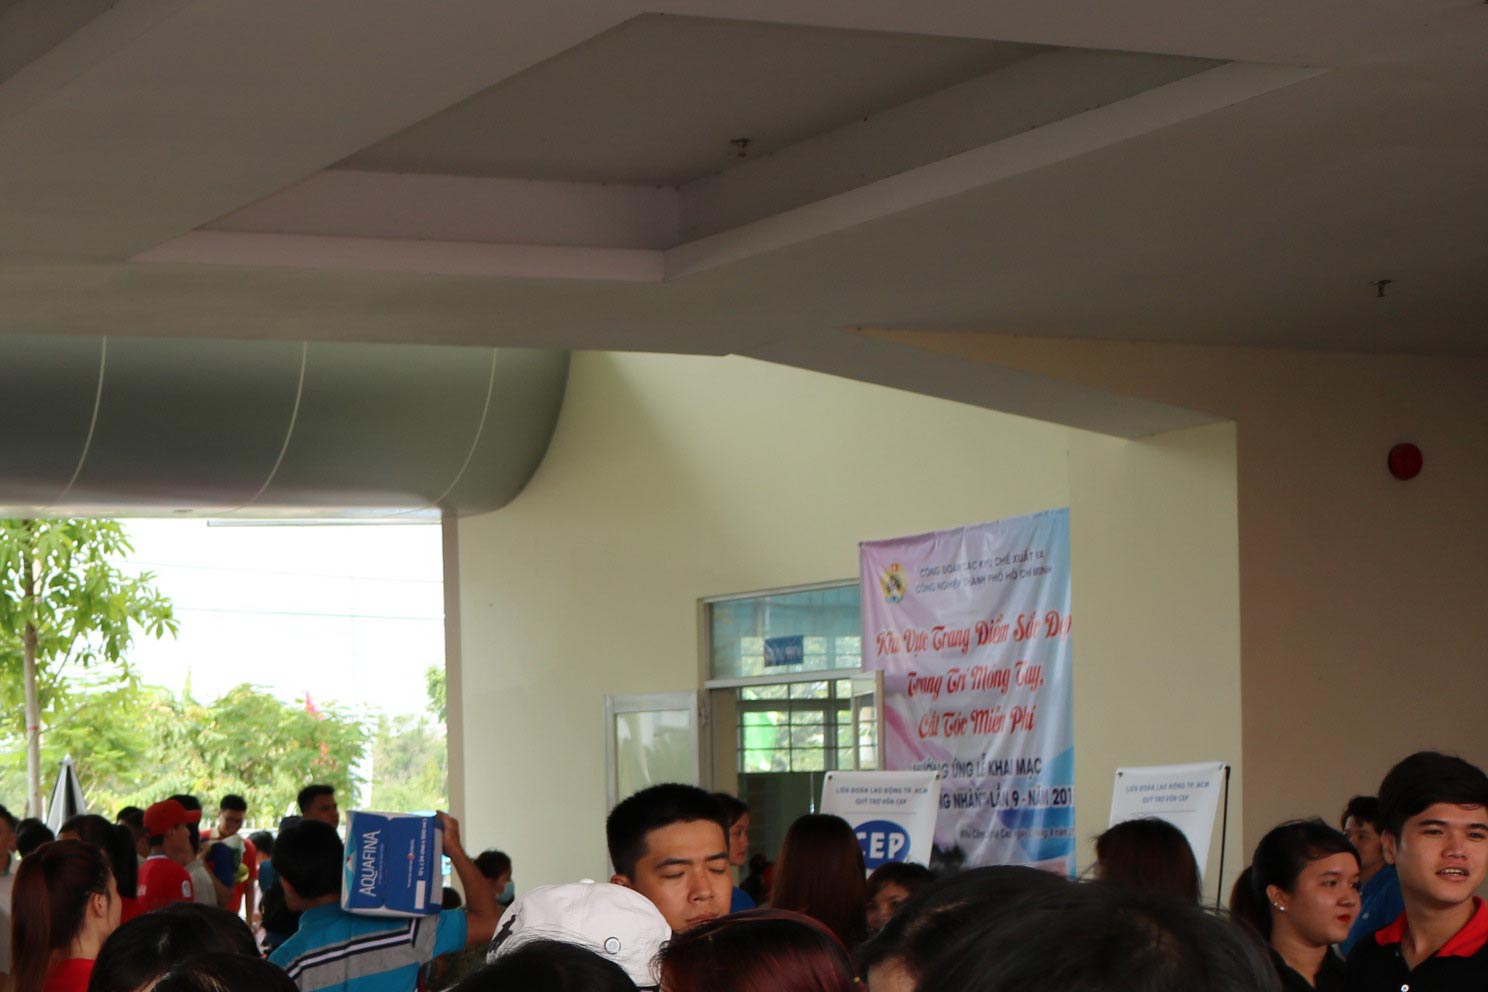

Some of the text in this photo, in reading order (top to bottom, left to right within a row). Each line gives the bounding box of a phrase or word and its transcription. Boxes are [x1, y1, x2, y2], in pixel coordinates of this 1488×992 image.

[931, 625, 971, 655] Trang
[906, 670, 944, 700] Trang
[1012, 789, 1019, 807] 9
[359, 828, 382, 897] AQUAFINA
